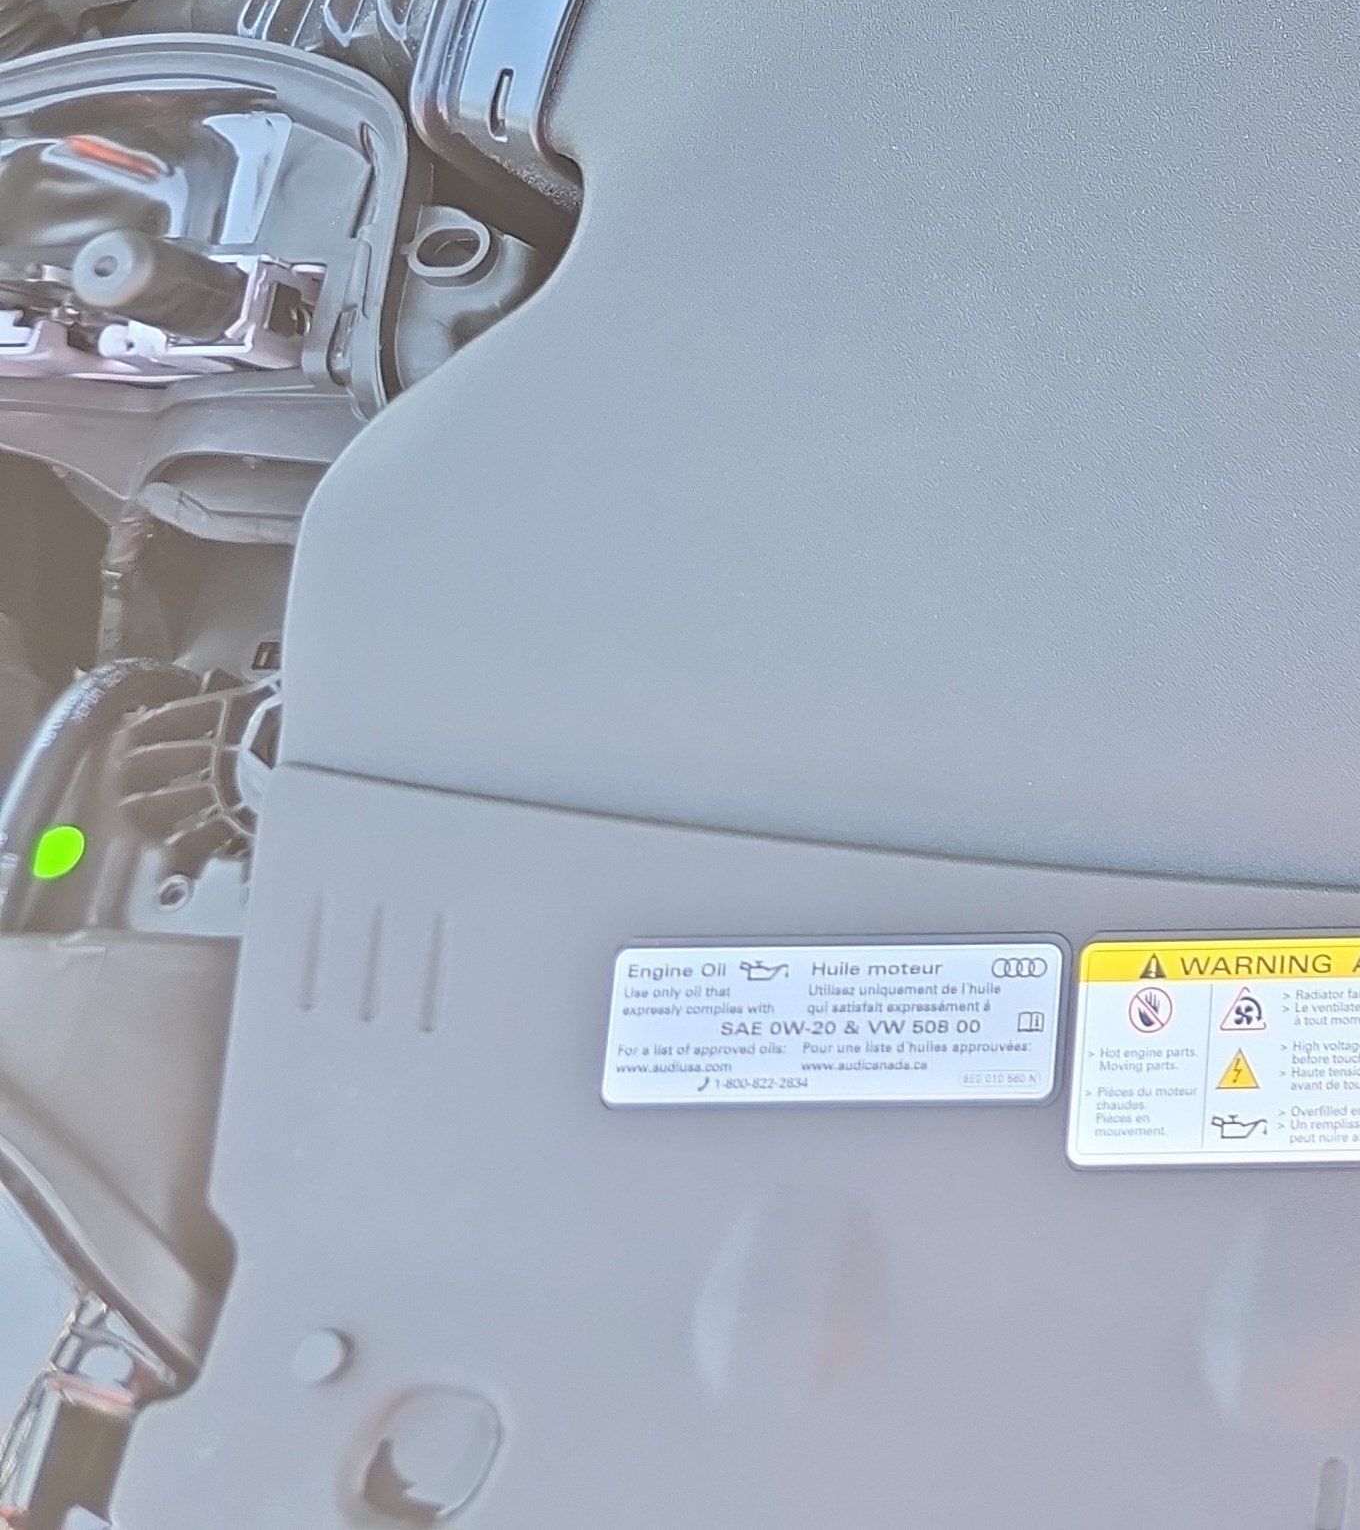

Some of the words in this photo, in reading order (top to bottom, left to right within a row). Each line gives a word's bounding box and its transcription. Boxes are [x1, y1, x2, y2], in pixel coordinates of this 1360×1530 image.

[628, 964, 693, 981] Engine
[702, 963, 726, 977] Oil
[812, 962, 860, 976] Huile
[868, 963, 943, 976] moteur
[1180, 955, 1332, 977] WARNING
[624, 986, 648, 998] Use
[653, 986, 680, 999] only
[685, 986, 700, 997] oil
[705, 986, 730, 997] that
[808, 984, 854, 996] Utilisez
[859, 984, 938, 997] uniquement
[941, 983, 957, 994] de
[1295, 989, 1344, 1001] Radiator
[623, 1004, 681, 1016] expressly
[686, 1004, 743, 1016] complies
[748, 1003, 775, 1014] with
[808, 1001, 827, 1014] qui
[832, 1000, 882, 1013] satisfait
[887, 1000, 978, 1014] expressément
[721, 1022, 762, 1035] SAE
[769, 1020, 836, 1035] 0W-20
[844, 1020, 859, 1034] &
[868, 1020, 905, 1034] VW
[912, 1020, 949, 1034] 508
[956, 1020, 981, 1033] 00
[617, 1045, 638, 1055] For
[642, 1047, 649, 1055] a
[654, 1044, 673, 1055] list
[677, 1044, 689, 1055] of
[694, 1044, 755, 1058] approved
[759, 1043, 786, 1054] oils:
[803, 1043, 832, 1053] Pour
[837, 1044, 861, 1053] une
[865, 1041, 892, 1052] liste
[1293, 1040, 1320, 1054] High
[1100, 1048, 1121, 1058] Hot
[1123, 1049, 1162, 1060] engine
[1166, 1048, 1198, 1058] parts.
[1292, 1053, 1329, 1065] before
[616, 1062, 732, 1073] www.audiusa.com
[801, 1061, 928, 1071] www.audicanada.ca
[1099, 1061, 1143, 1073] Moving
[1147, 1061, 1178, 1072] parts.
[1291, 1105, 1347, 1117] Overfilled
